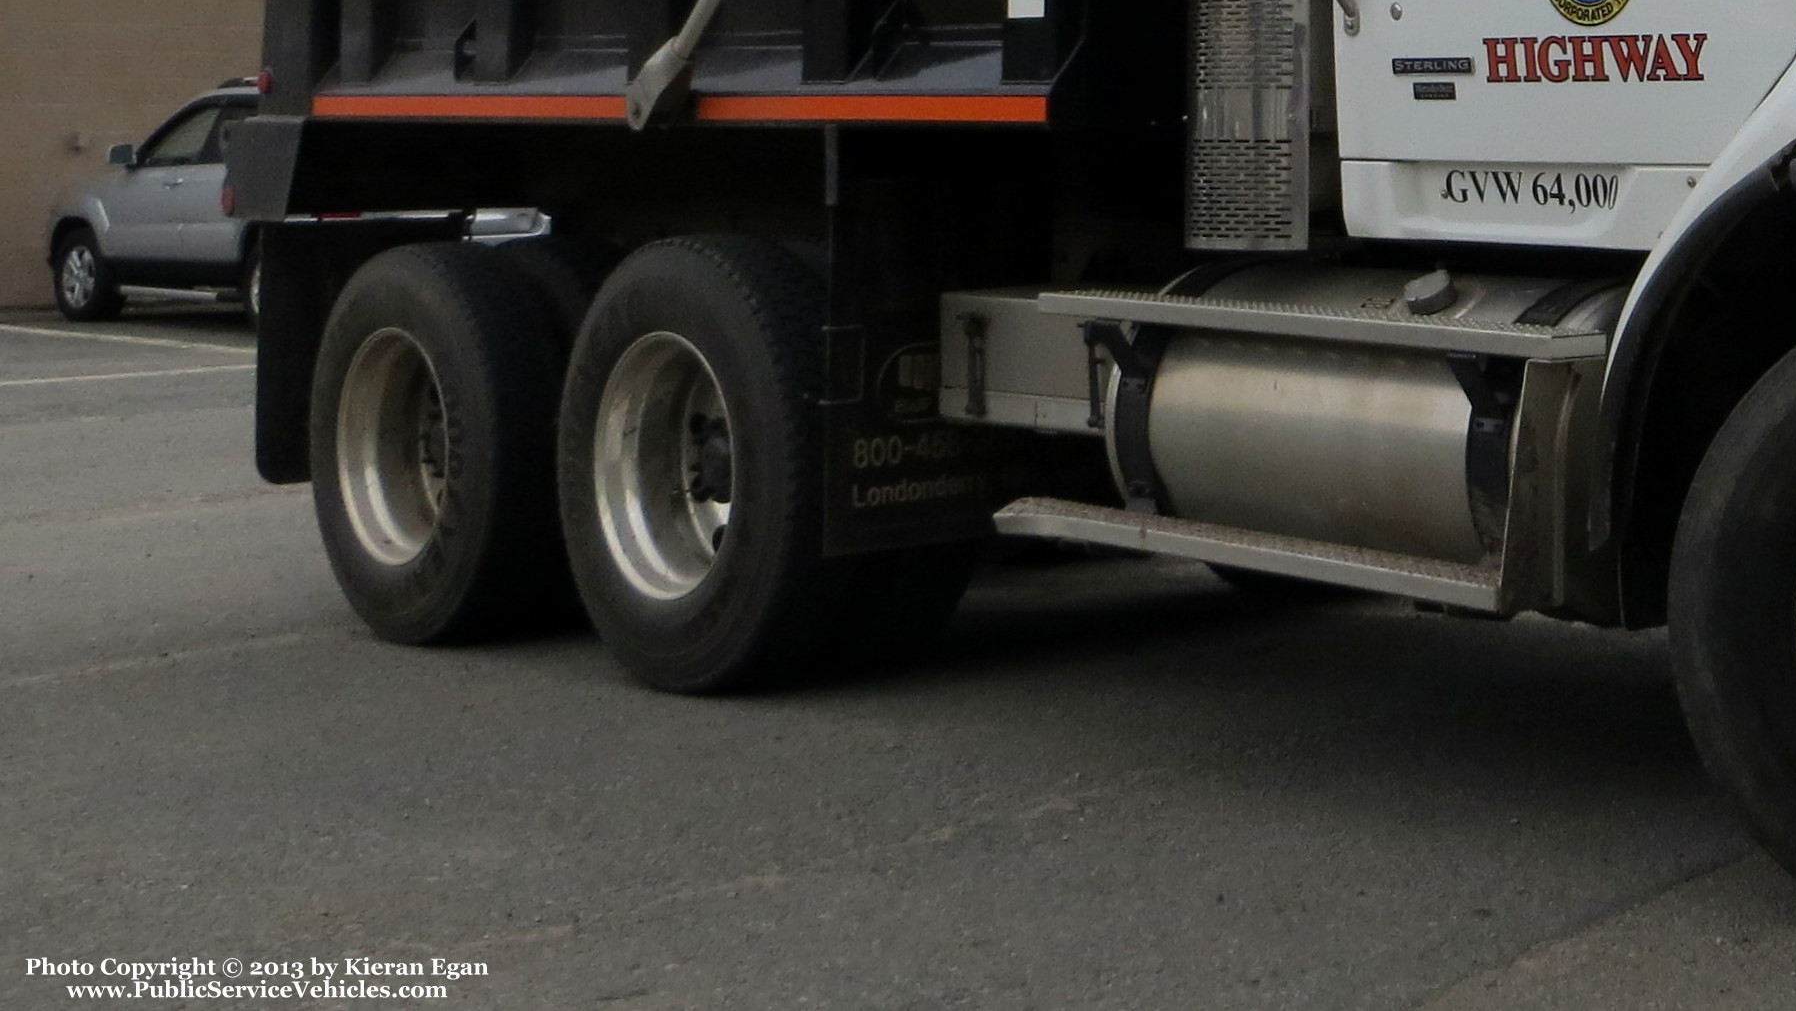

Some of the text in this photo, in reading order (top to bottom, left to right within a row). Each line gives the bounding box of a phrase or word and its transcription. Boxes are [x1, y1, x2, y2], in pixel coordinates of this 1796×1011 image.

[1394, 59, 1470, 71] STERLING
[1482, 34, 1708, 83] HIGHWAY
[1445, 169, 1619, 214] GVW 64,000
